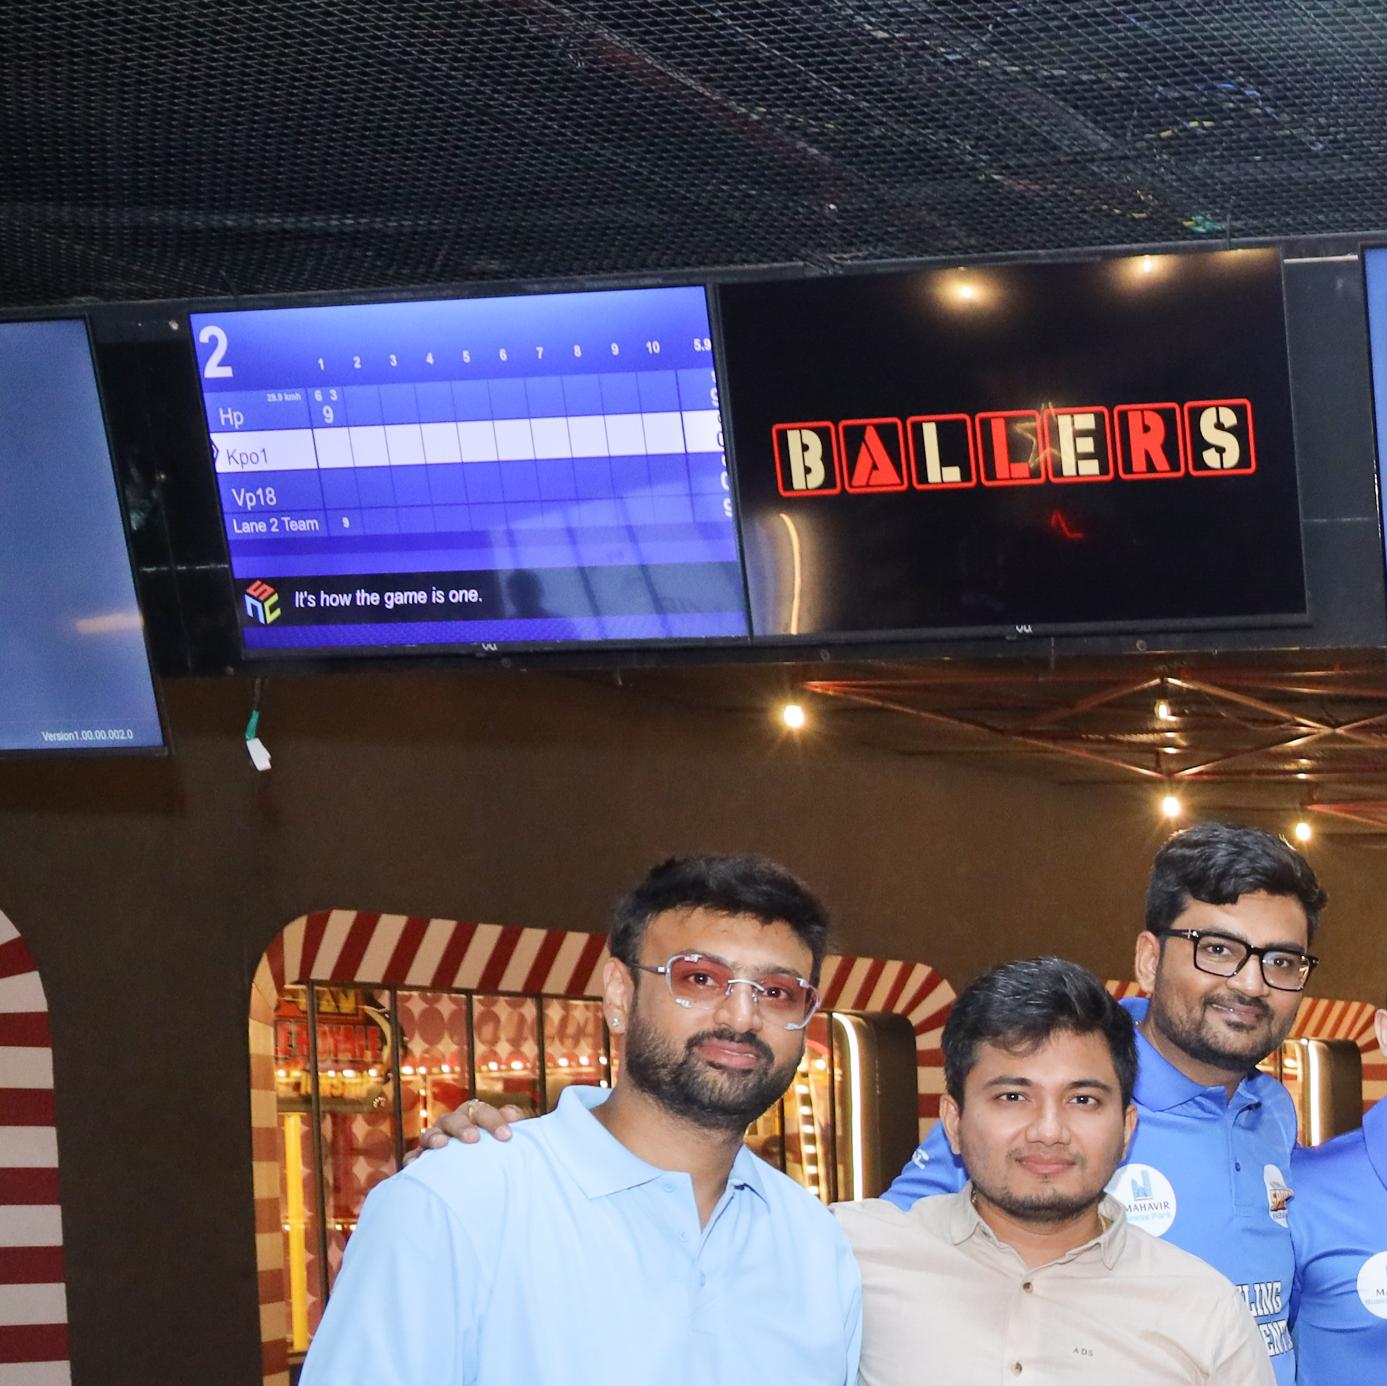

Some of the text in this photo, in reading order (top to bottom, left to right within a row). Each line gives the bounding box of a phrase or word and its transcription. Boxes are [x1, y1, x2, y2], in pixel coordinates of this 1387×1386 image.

[199, 325, 233, 378] 2
[318, 358, 325, 371] 1
[353, 356, 362, 368] 2
[390, 354, 398, 366] 3
[426, 352, 434, 365] 4
[462, 350, 471, 363] 5
[499, 348, 507, 361] 6
[536, 346, 544, 359] 7
[574, 344, 582, 357] 8
[611, 342, 620, 356] 9
[646, 341, 661, 354] 10
[315, 390, 323, 401] 6
[330, 389, 338, 401] 3
[219, 406, 244, 429] Hp
[322, 406, 334, 424] 9
[787, 406, 1241, 490] BALLERS
[232, 487, 277, 511] Vp18
[233, 518, 267, 534] Lane
[270, 518, 279, 532] 2
[281, 515, 320, 531] Team
[342, 517, 350, 529] 9
[295, 588, 483, 609] It's how the game is one.
[41, 728, 134, 743] Version1.00.00.002.0
